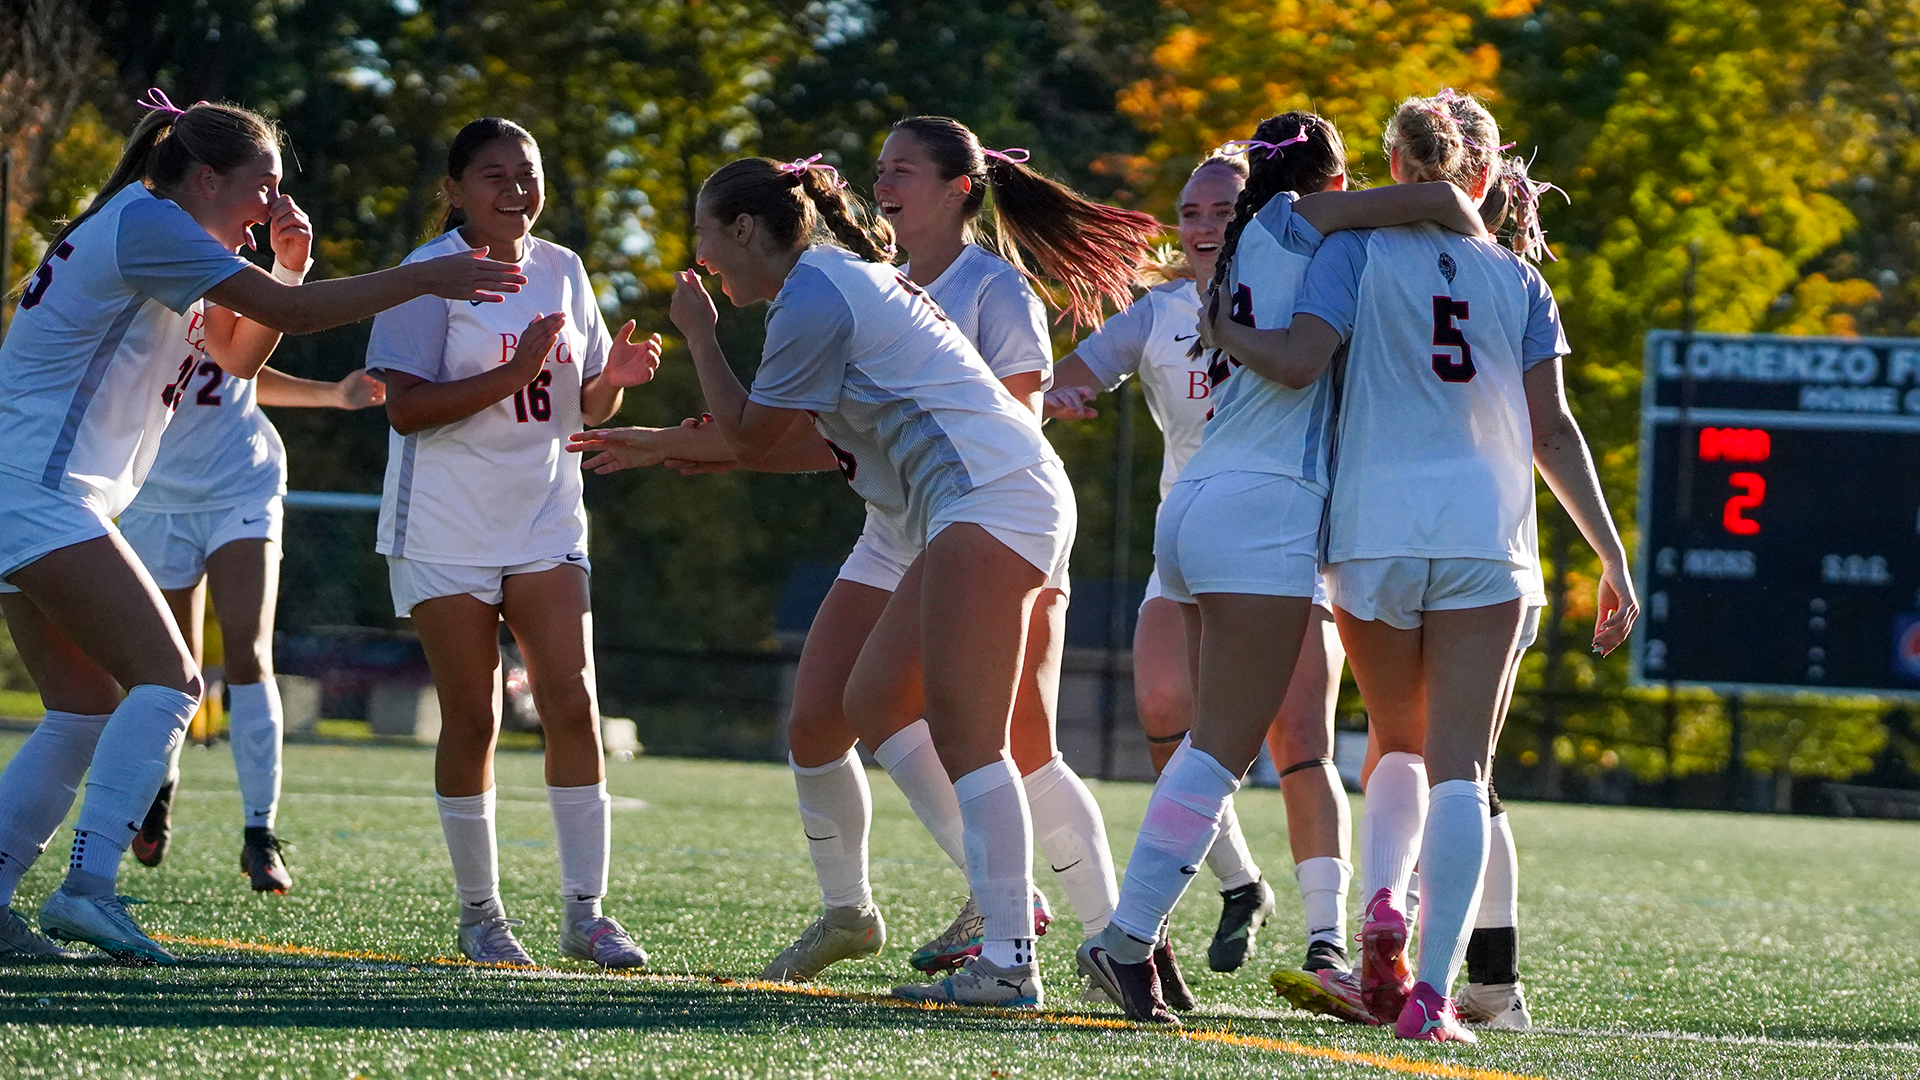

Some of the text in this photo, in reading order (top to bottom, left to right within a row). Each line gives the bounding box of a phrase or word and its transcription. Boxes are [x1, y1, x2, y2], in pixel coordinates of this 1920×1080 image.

[498, 331, 573, 363] Bd
[1432, 295, 1477, 383] 5
[1659, 341, 1879, 384] LORENZO
[514, 369, 553, 423] 16
[1722, 471, 1766, 534] 2
